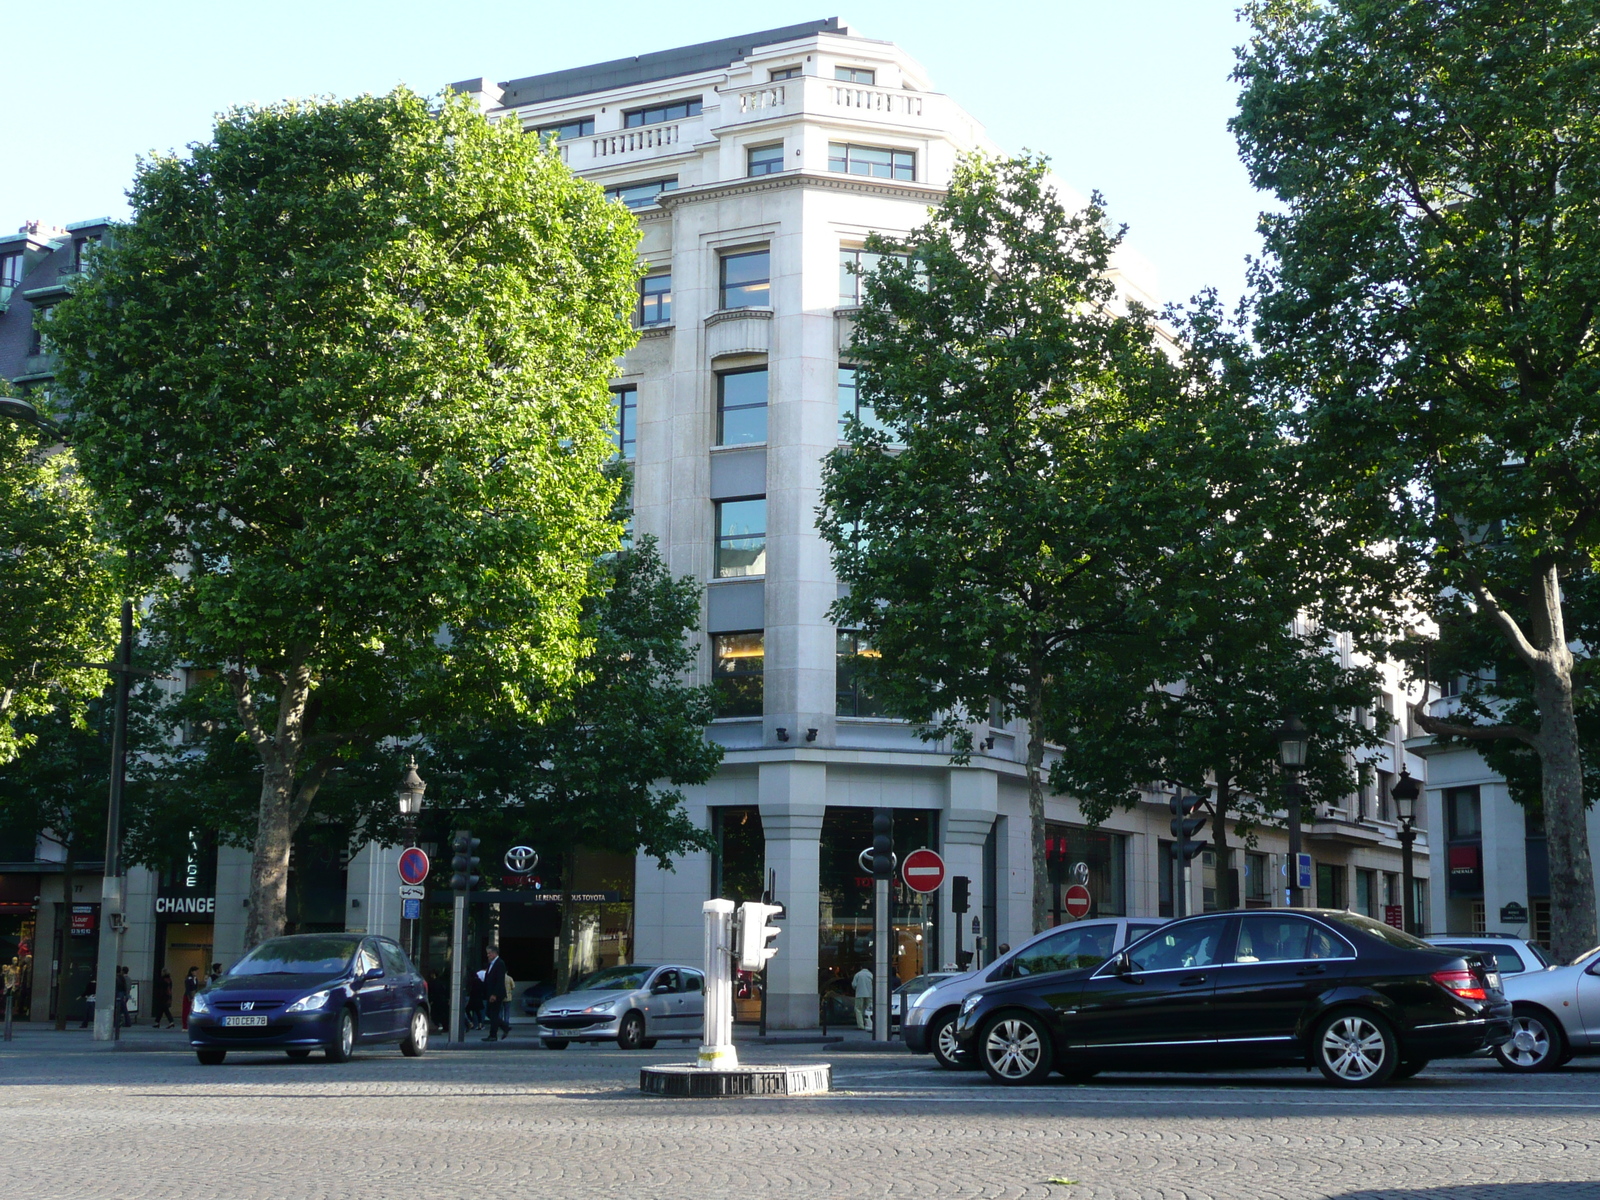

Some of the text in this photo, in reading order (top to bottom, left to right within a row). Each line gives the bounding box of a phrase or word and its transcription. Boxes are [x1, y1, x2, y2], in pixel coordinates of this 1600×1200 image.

[582, 894, 606, 902] TOYOTA
[156, 897, 215, 913] CHANGE
[226, 1016, 266, 1026] 210 CER 78
